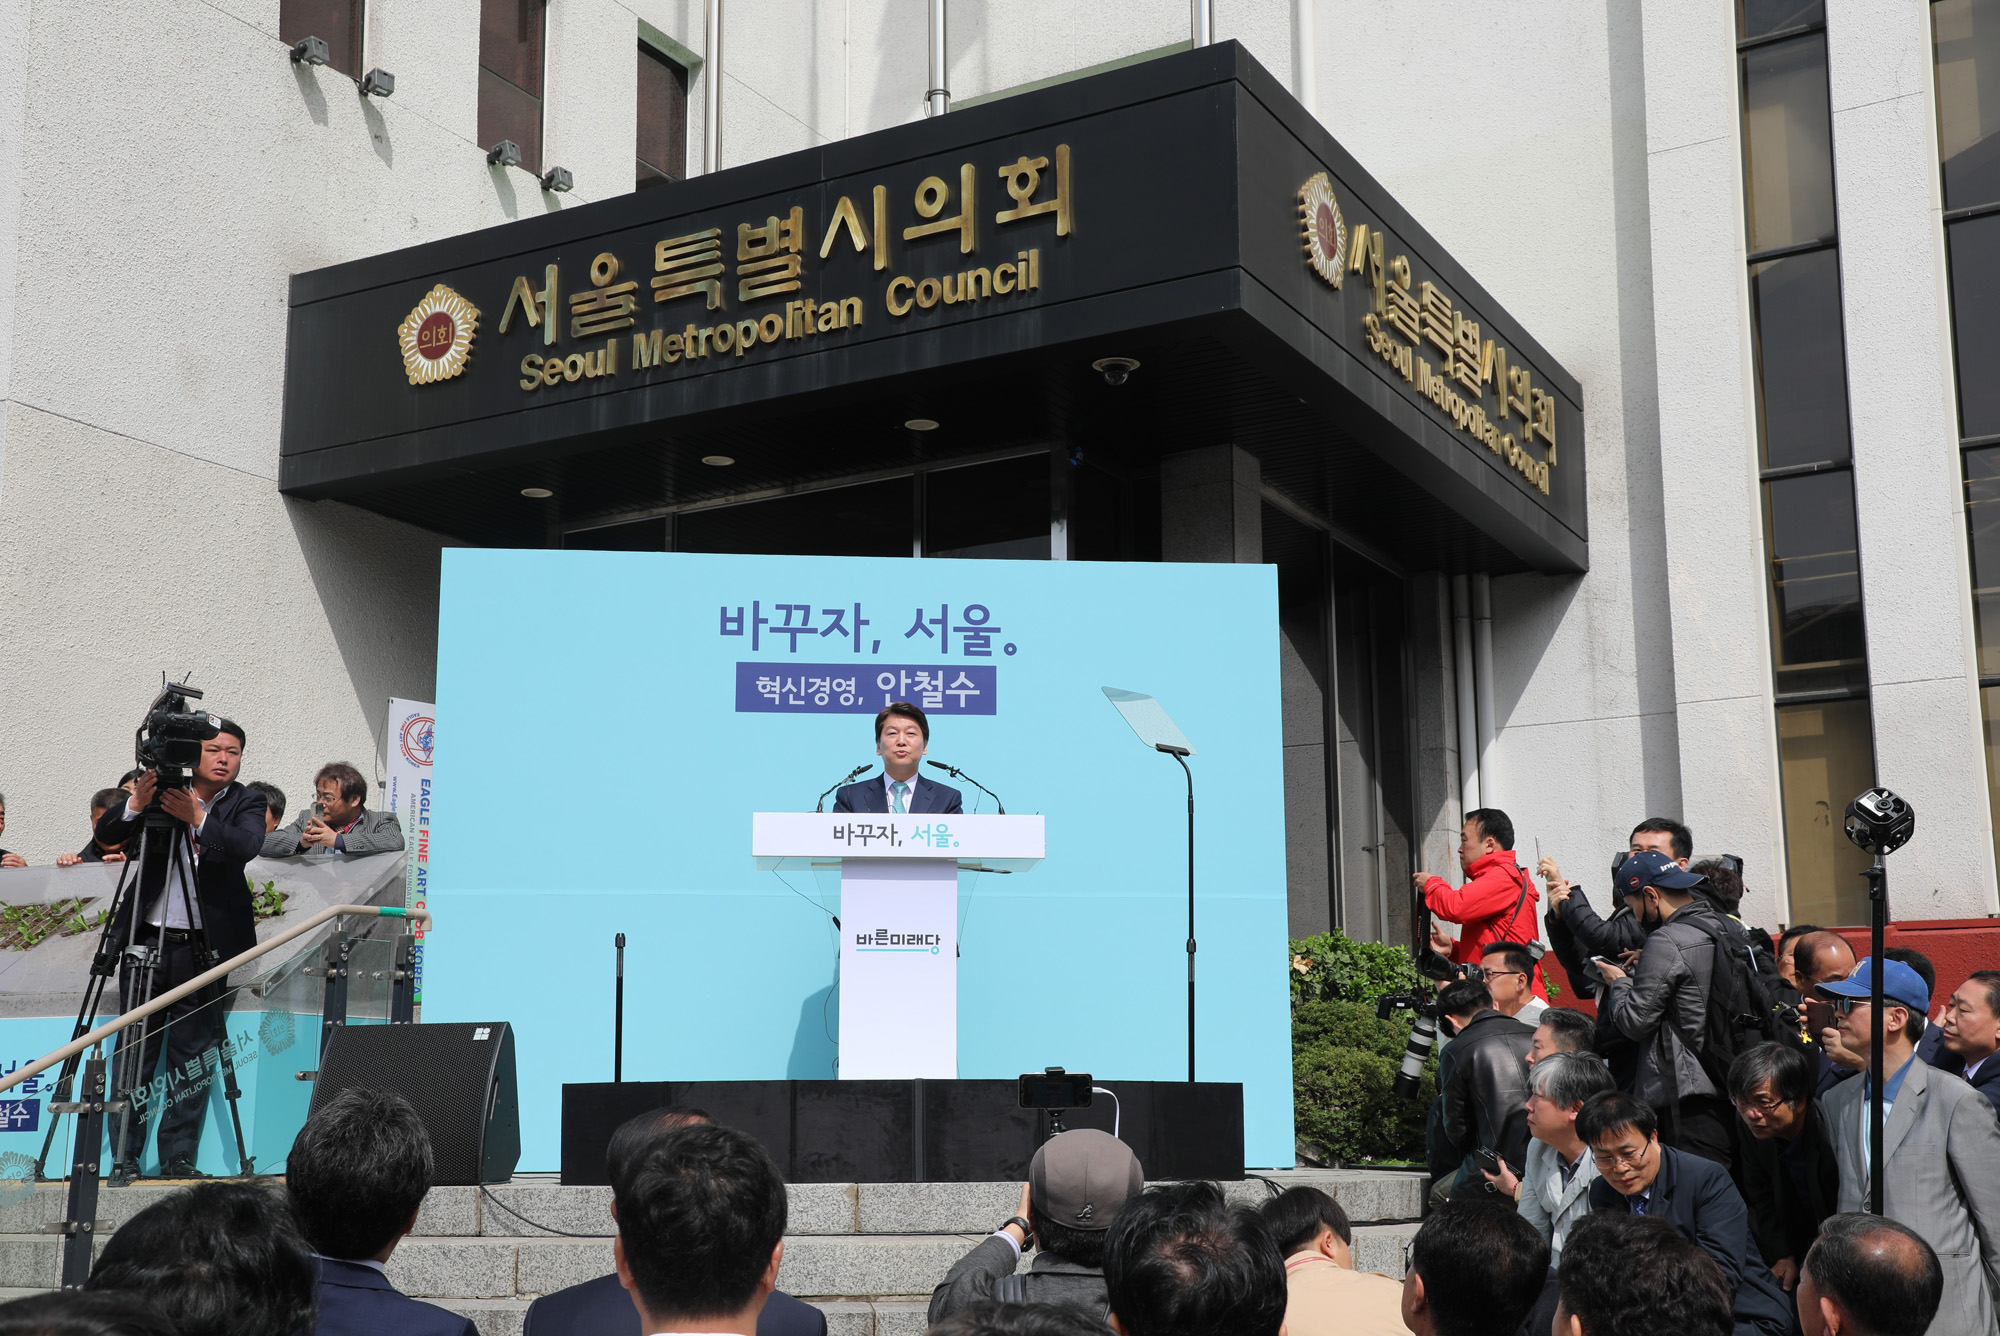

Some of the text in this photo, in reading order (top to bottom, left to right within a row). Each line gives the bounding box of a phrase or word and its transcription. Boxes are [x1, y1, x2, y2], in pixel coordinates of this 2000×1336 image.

[500, 143, 1070, 346] 서울특별시의회
[1318, 217, 1337, 250] 의회
[419, 321, 453, 349] 의회
[519, 248, 1039, 391] Seoul Metropolitan Council
[1350, 223, 1557, 467] 서울특별시의회
[1365, 313, 1550, 496] Seoul Metropolitan Council
[719, 600, 881, 655] 바꾸자,
[755, 669, 981, 709] 혁신경영, 안철수
[418, 778, 431, 826] EAGLE
[417, 829, 430, 864] FINE
[832, 822, 903, 848] 바꾸자,
[415, 866, 428, 897] ART
[855, 928, 941, 955] 바른미래당
[413, 944, 425, 996] KOREA
